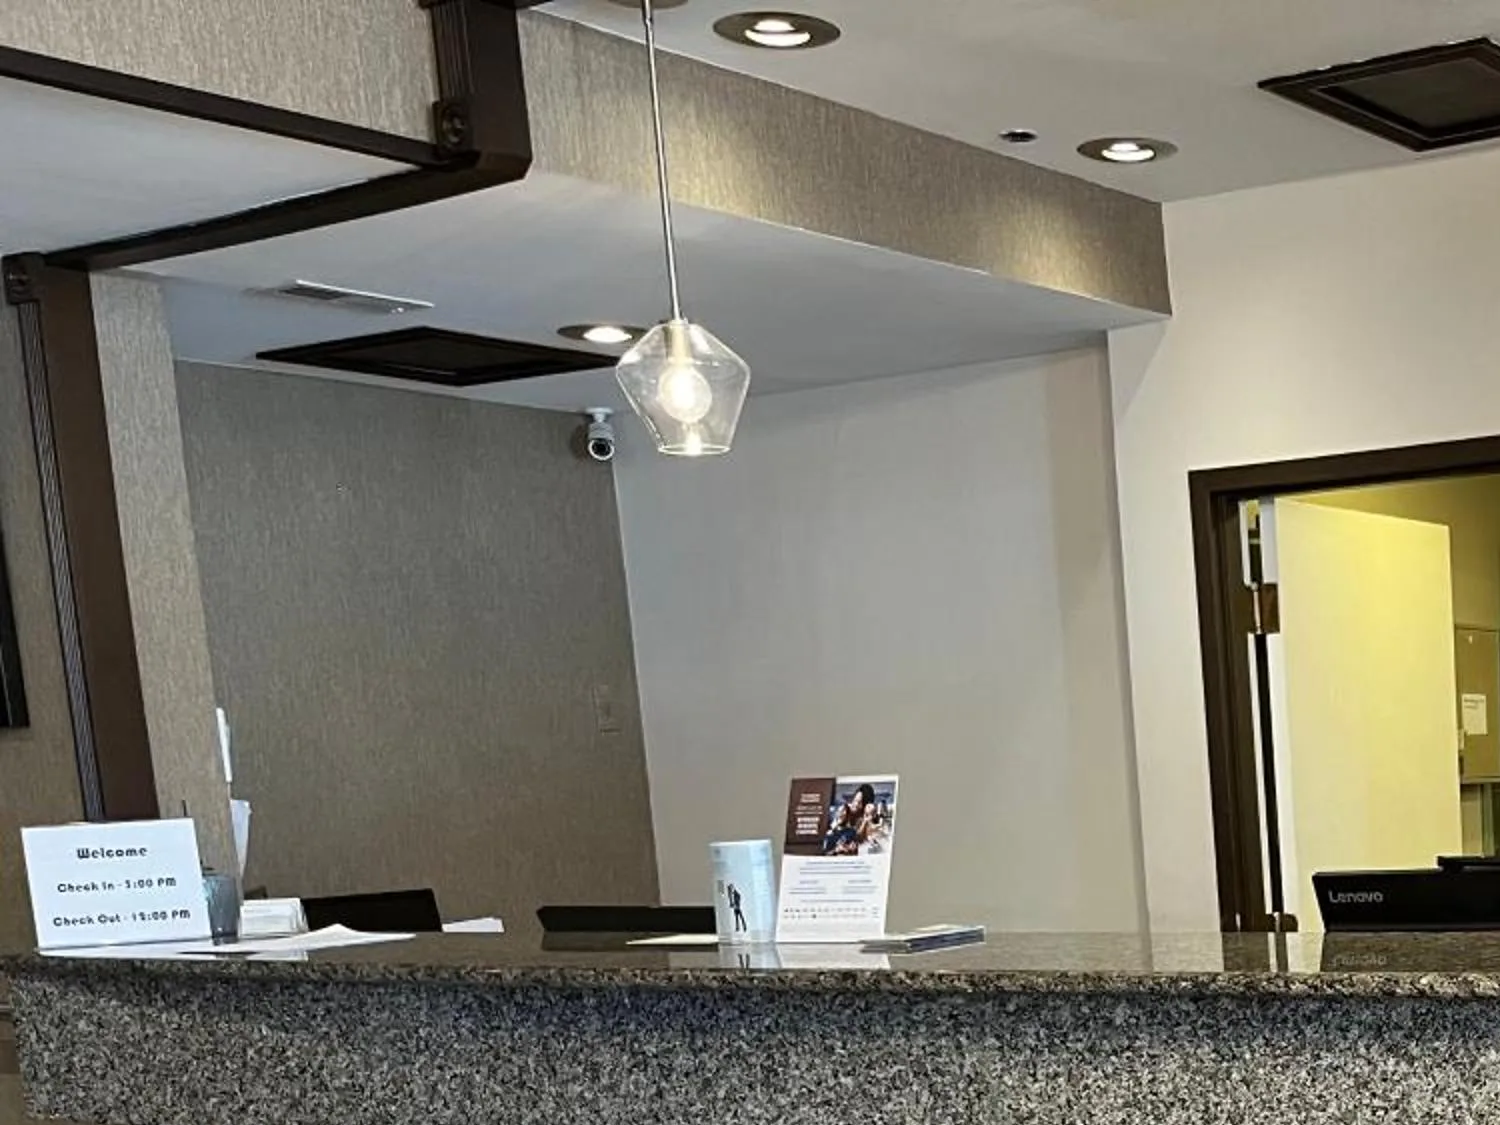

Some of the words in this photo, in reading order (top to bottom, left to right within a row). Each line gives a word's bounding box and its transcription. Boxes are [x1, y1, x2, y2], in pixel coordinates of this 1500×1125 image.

[76, 846, 149, 860] Welcome
[57, 880, 100, 893] Check
[102, 880, 116, 892] In
[157, 876, 177, 888] PM
[1328, 889, 1384, 904] Lenovo
[53, 913, 95, 927] Check
[97, 912, 121, 926] Out
[171, 908, 191, 920] PM
